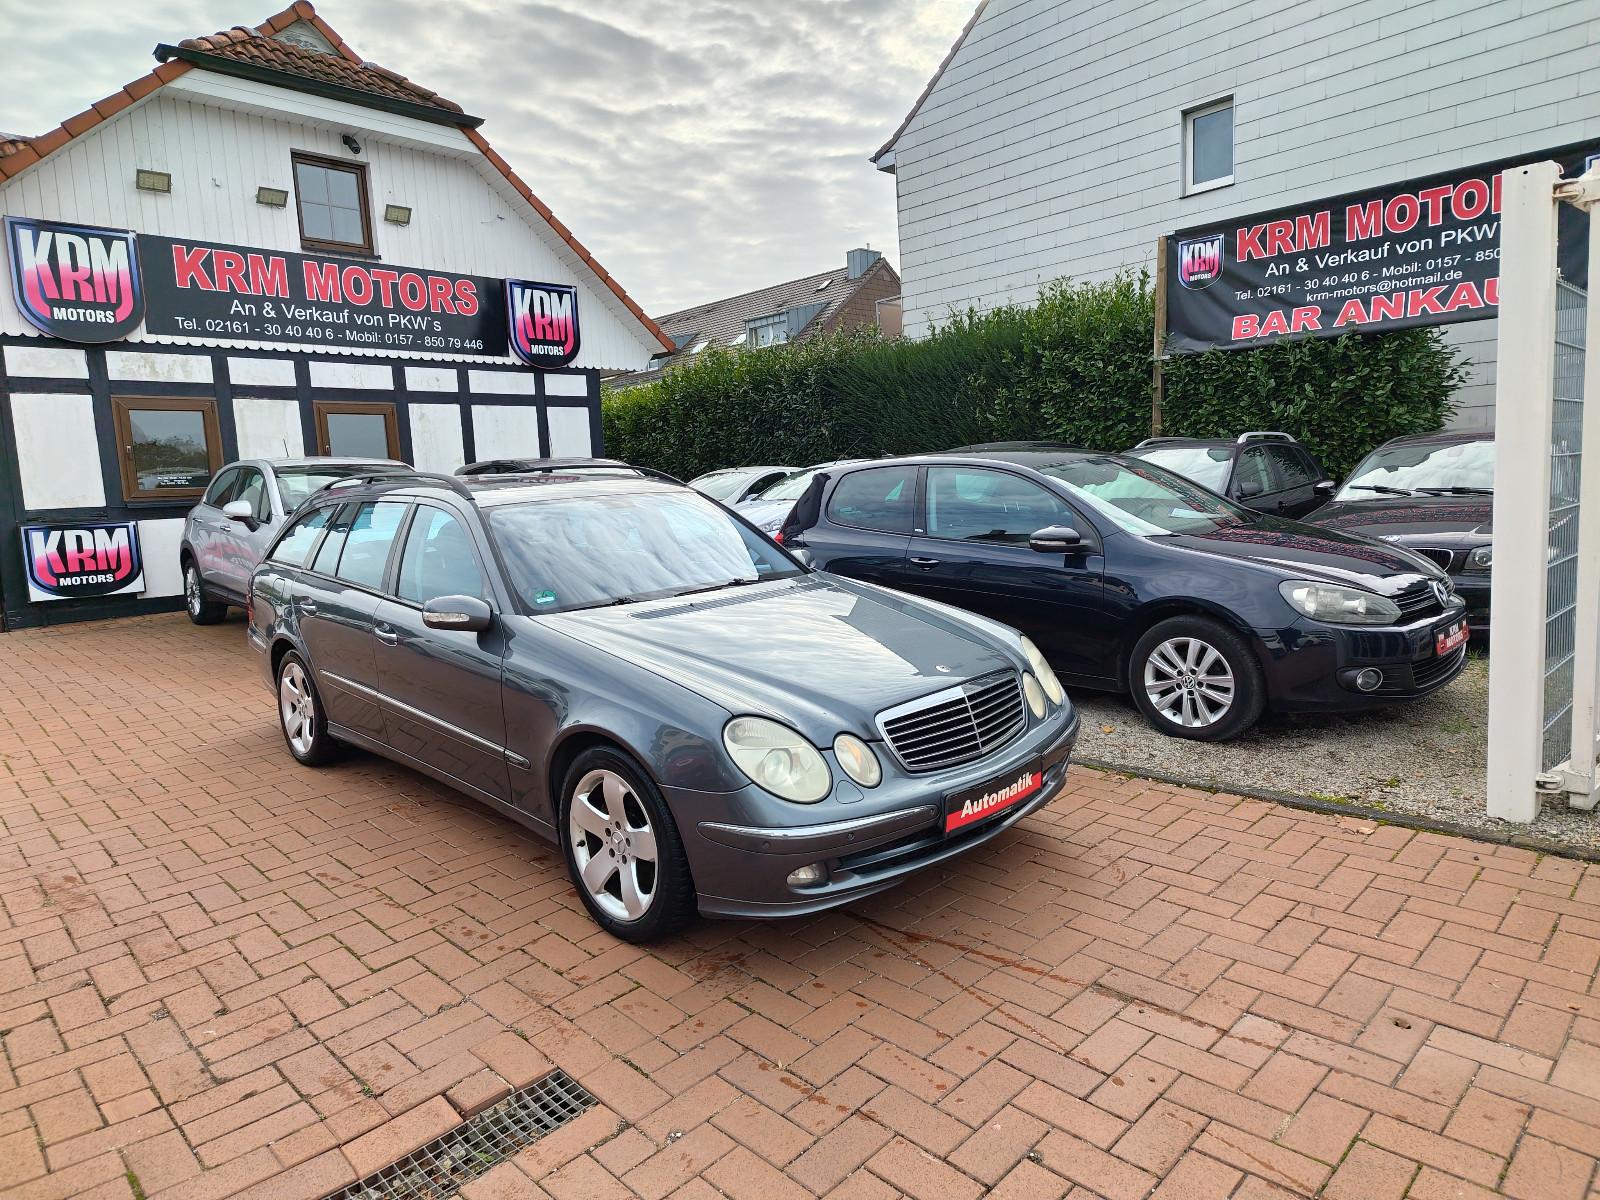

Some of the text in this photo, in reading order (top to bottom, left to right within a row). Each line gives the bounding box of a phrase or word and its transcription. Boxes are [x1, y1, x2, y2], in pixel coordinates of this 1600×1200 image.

[1236, 174, 1503, 263] KRM MOTO
[18, 228, 134, 323] KRM
[1181, 239, 1220, 281] KRM
[1235, 290, 1254, 301] Tel.
[1257, 283, 1292, 297] 02161
[1304, 278, 1319, 290] 30
[1322, 276, 1338, 287] 40
[1341, 273, 1358, 284] 40
[1361, 270, 1370, 281] 6
[1382, 261, 1422, 277] Mobil:
[1426, 254, 1462, 270] 0157
[1265, 262, 1290, 278] An
[1295, 257, 1309, 272] &
[1315, 241, 1391, 269] Verkauf
[1395, 238, 1433, 255] von
[172, 244, 479, 317] KRM MOTORS
[1306, 269, 1463, 302] krm-motors@hotmail.de
[53, 306, 115, 324] MOTORS
[174, 316, 201, 331] Tel.
[205, 319, 249, 334] 02161
[264, 323, 281, 336] 30
[285, 325, 302, 337] 40
[305, 327, 322, 339] 40
[325, 329, 334, 340] 6
[346, 329, 382, 343] Mobil:
[385, 333, 413, 345] 0157
[424, 336, 445, 348] 850
[448, 337, 461, 349] 79
[463, 339, 483, 350] 446
[229, 299, 257, 317] An
[262, 301, 277, 318] &
[281, 303, 349, 324] Verkauf
[354, 313, 384, 327] von
[512, 287, 574, 356] KRM
[1231, 304, 1323, 341] BAR
[531, 343, 564, 356] MOTORS
[31, 527, 132, 587] KRM
[59, 573, 115, 587] MOTORS
[960, 771, 1033, 818] Automatik
